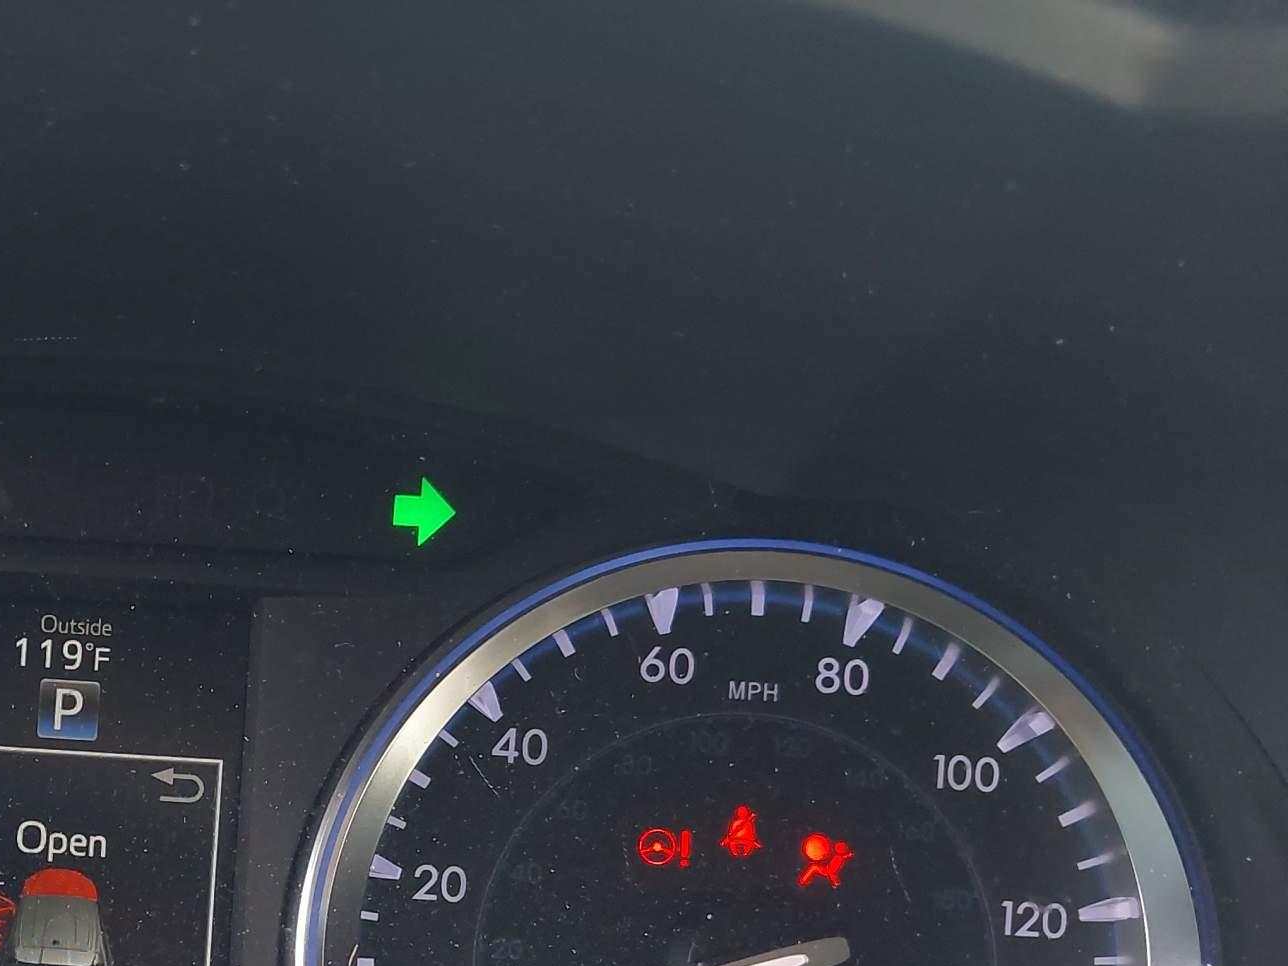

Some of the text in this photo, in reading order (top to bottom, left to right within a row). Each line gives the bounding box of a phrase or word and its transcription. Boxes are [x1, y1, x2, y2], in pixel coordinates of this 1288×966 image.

[41, 614, 112, 637] Outside
[640, 646, 695, 685] 60
[815, 657, 869, 696] 80
[53, 687, 84, 731] P
[728, 680, 778, 702] MPH
[491, 727, 548, 766] 40
[933, 754, 1000, 793] 100
[16, 820, 107, 862] Open
[412, 864, 467, 903] 20
[1001, 900, 1067, 939] 120
